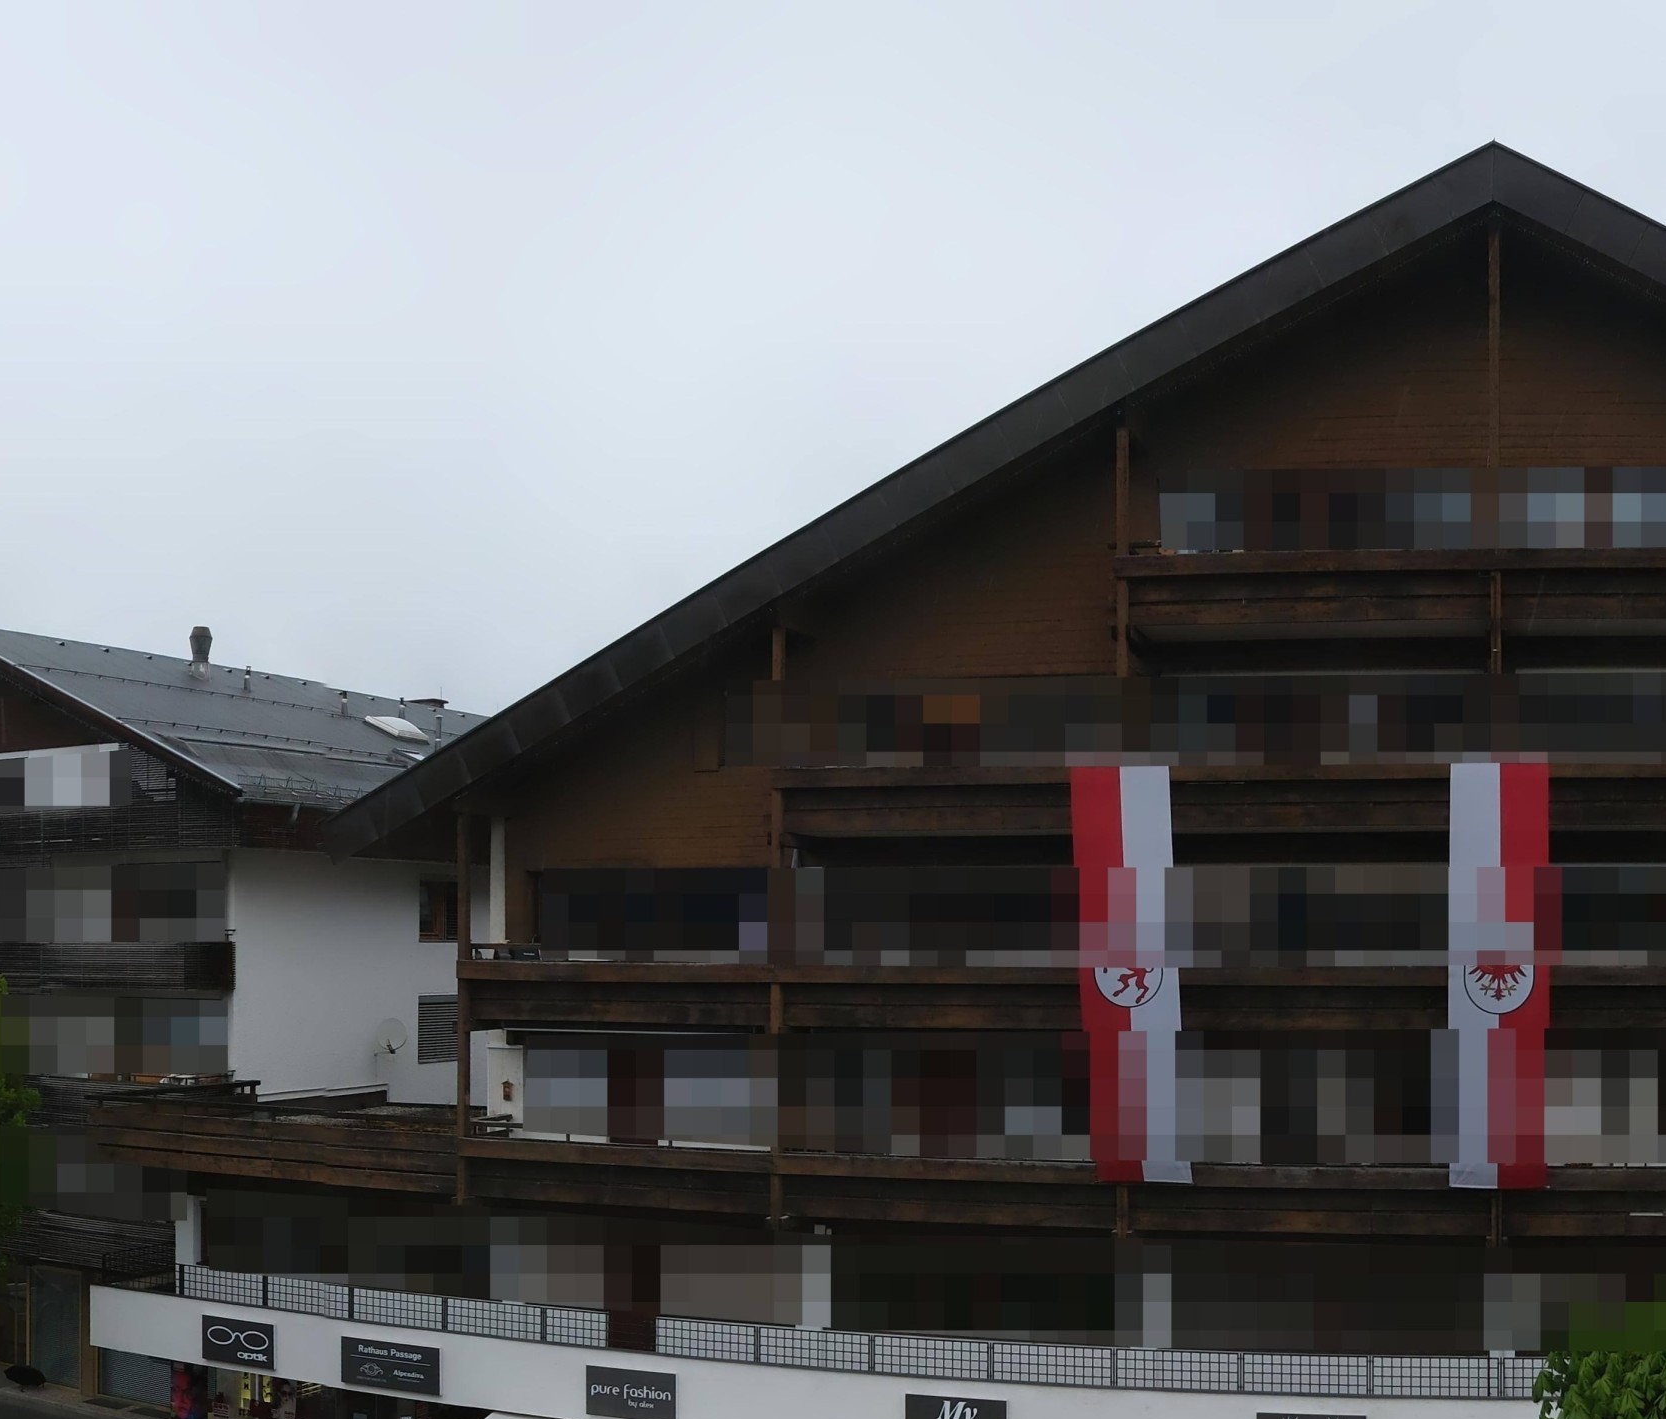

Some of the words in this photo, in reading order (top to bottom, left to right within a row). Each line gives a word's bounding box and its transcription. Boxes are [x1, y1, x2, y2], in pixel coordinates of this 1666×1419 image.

[237, 1351, 269, 1362] optik
[358, 1344, 389, 1356] Rathaus
[390, 1348, 422, 1361] Passage
[590, 1384, 621, 1397] pure
[623, 1383, 672, 1401] fashion
[628, 1400, 638, 1409] by
[639, 1401, 655, 1409] alex
